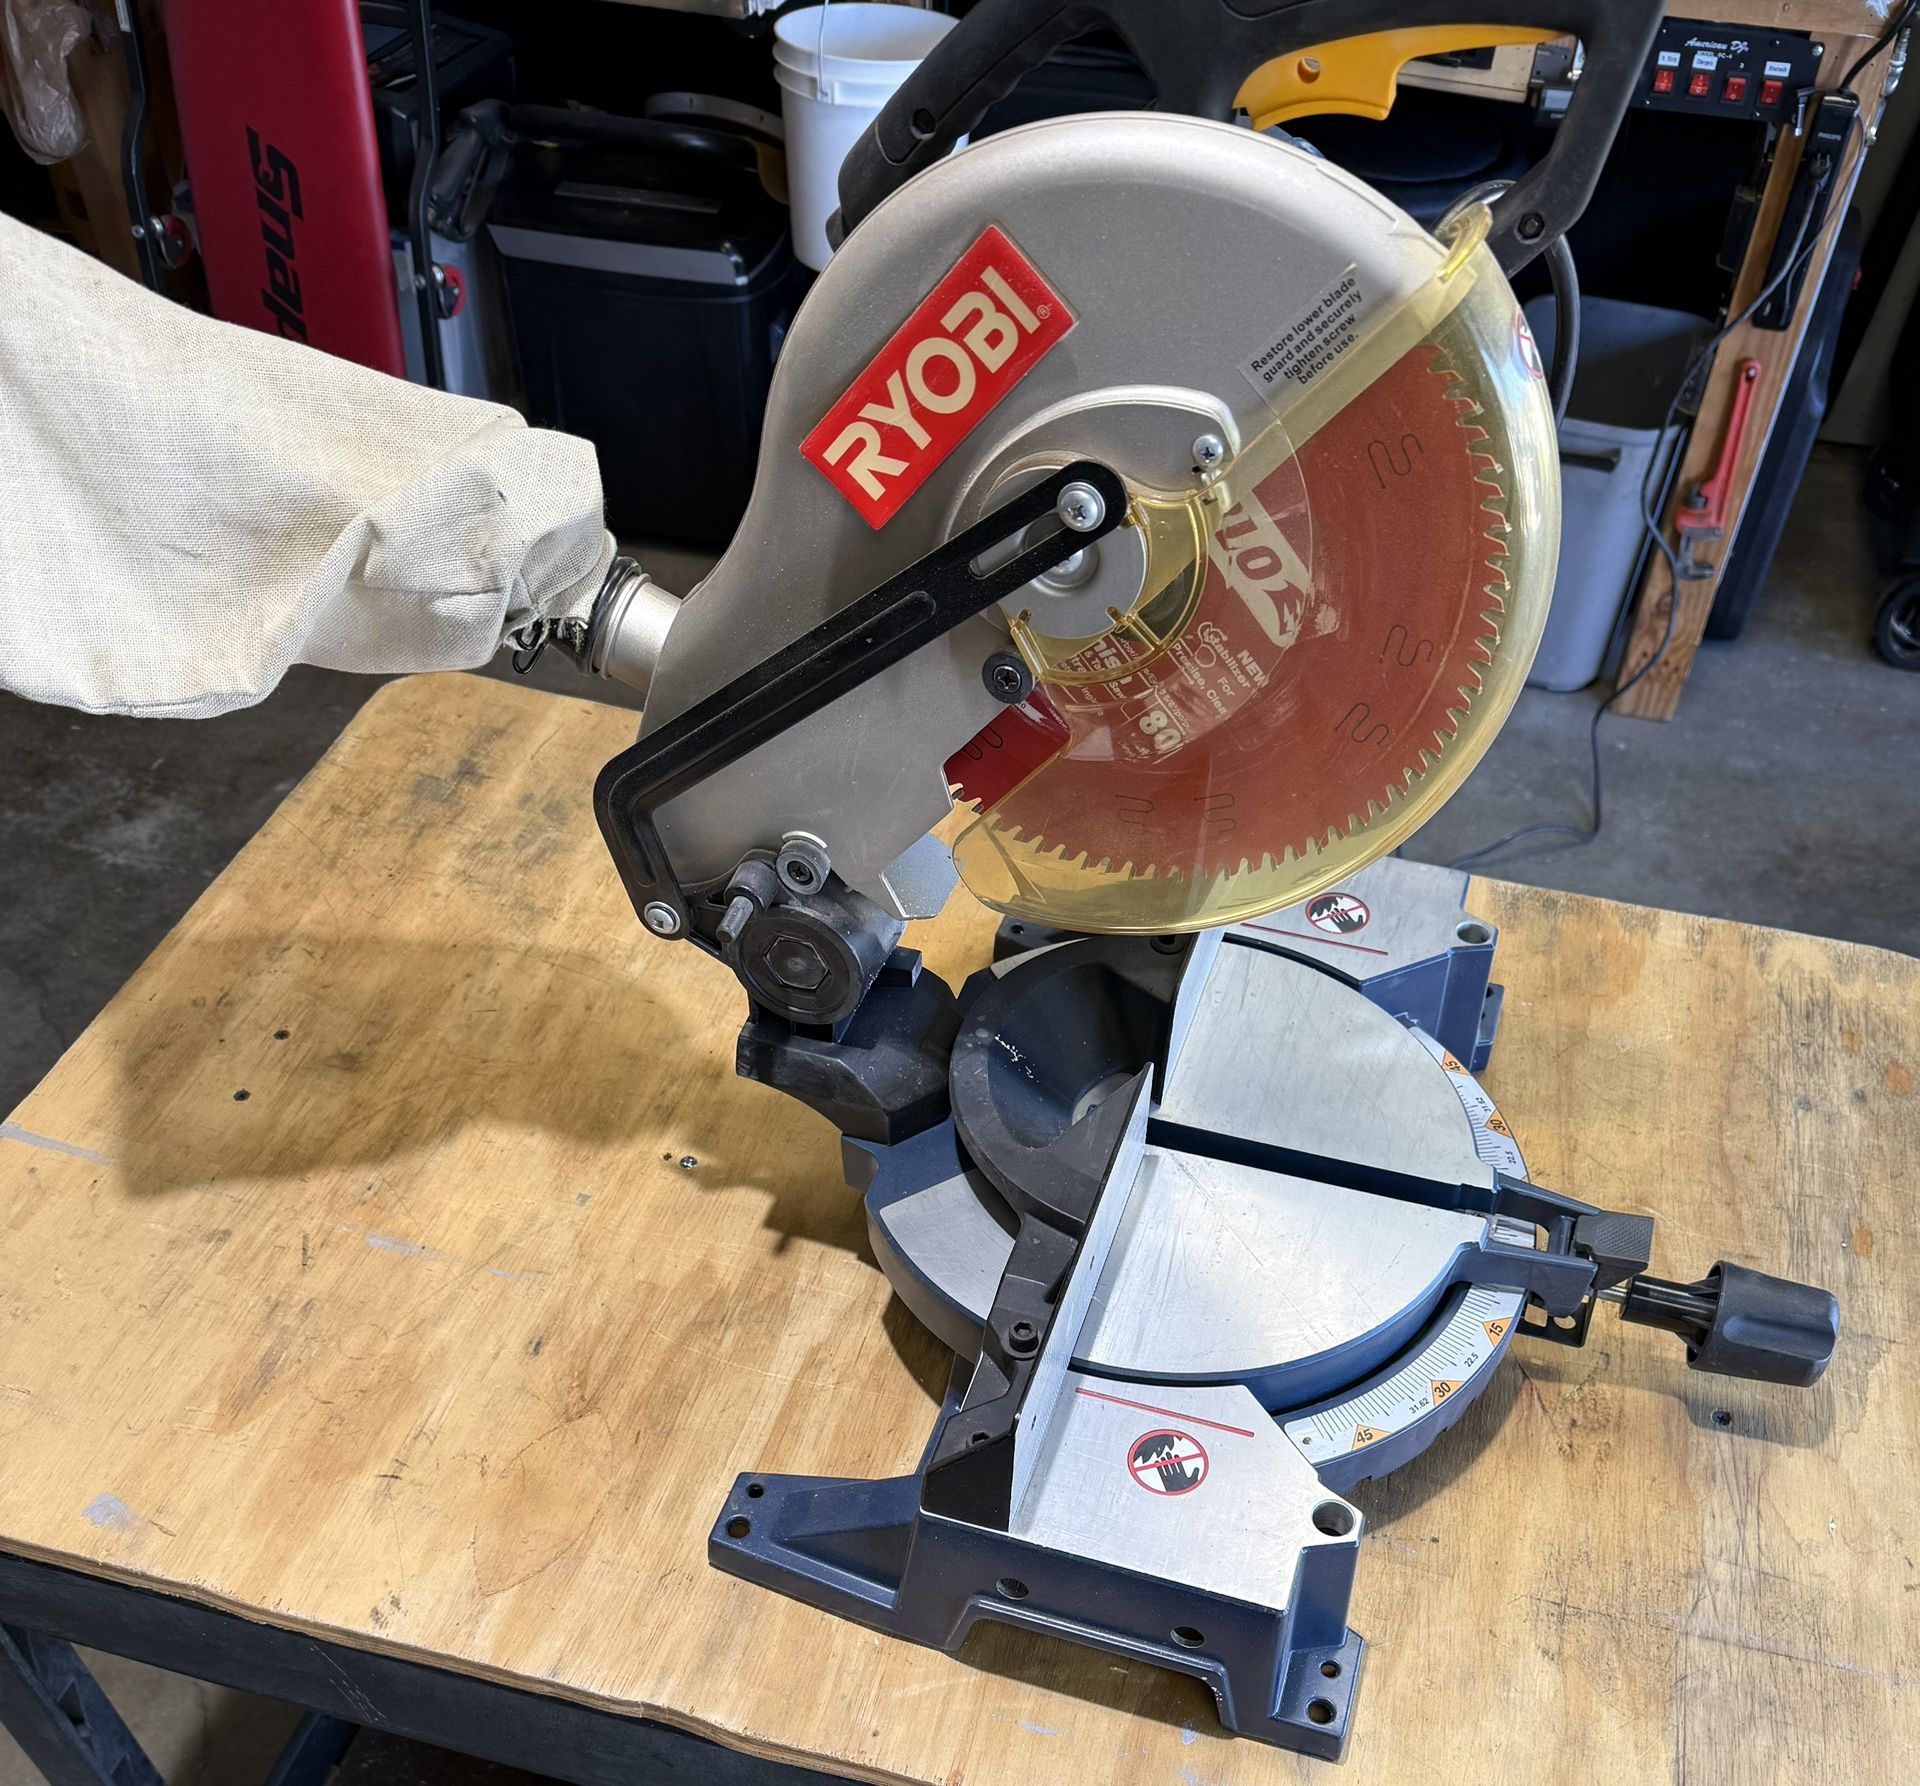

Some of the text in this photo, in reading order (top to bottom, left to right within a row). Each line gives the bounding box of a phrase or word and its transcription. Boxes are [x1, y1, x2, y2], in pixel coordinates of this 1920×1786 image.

[1251, 277, 1356, 372] Restore lower blade
[1263, 290, 1363, 383] guard and securely
[1283, 314, 1356, 379] tighten screw
[1297, 333, 1359, 385] before use.
[822, 265, 1041, 502] RYOBI
[1237, 650, 1269, 688] NEW
[1217, 676, 1235, 696] For
[1139, 710, 1181, 751] 80
[1445, 1059, 1461, 1072] 45
[1490, 1119, 1506, 1132] 30
[1488, 1322, 1504, 1337] 15
[1464, 1352, 1479, 1367] 22.5
[1434, 1381, 1451, 1398] 30
[1409, 1398, 1429, 1414] 31.62
[1356, 1429, 1374, 1443] 45
